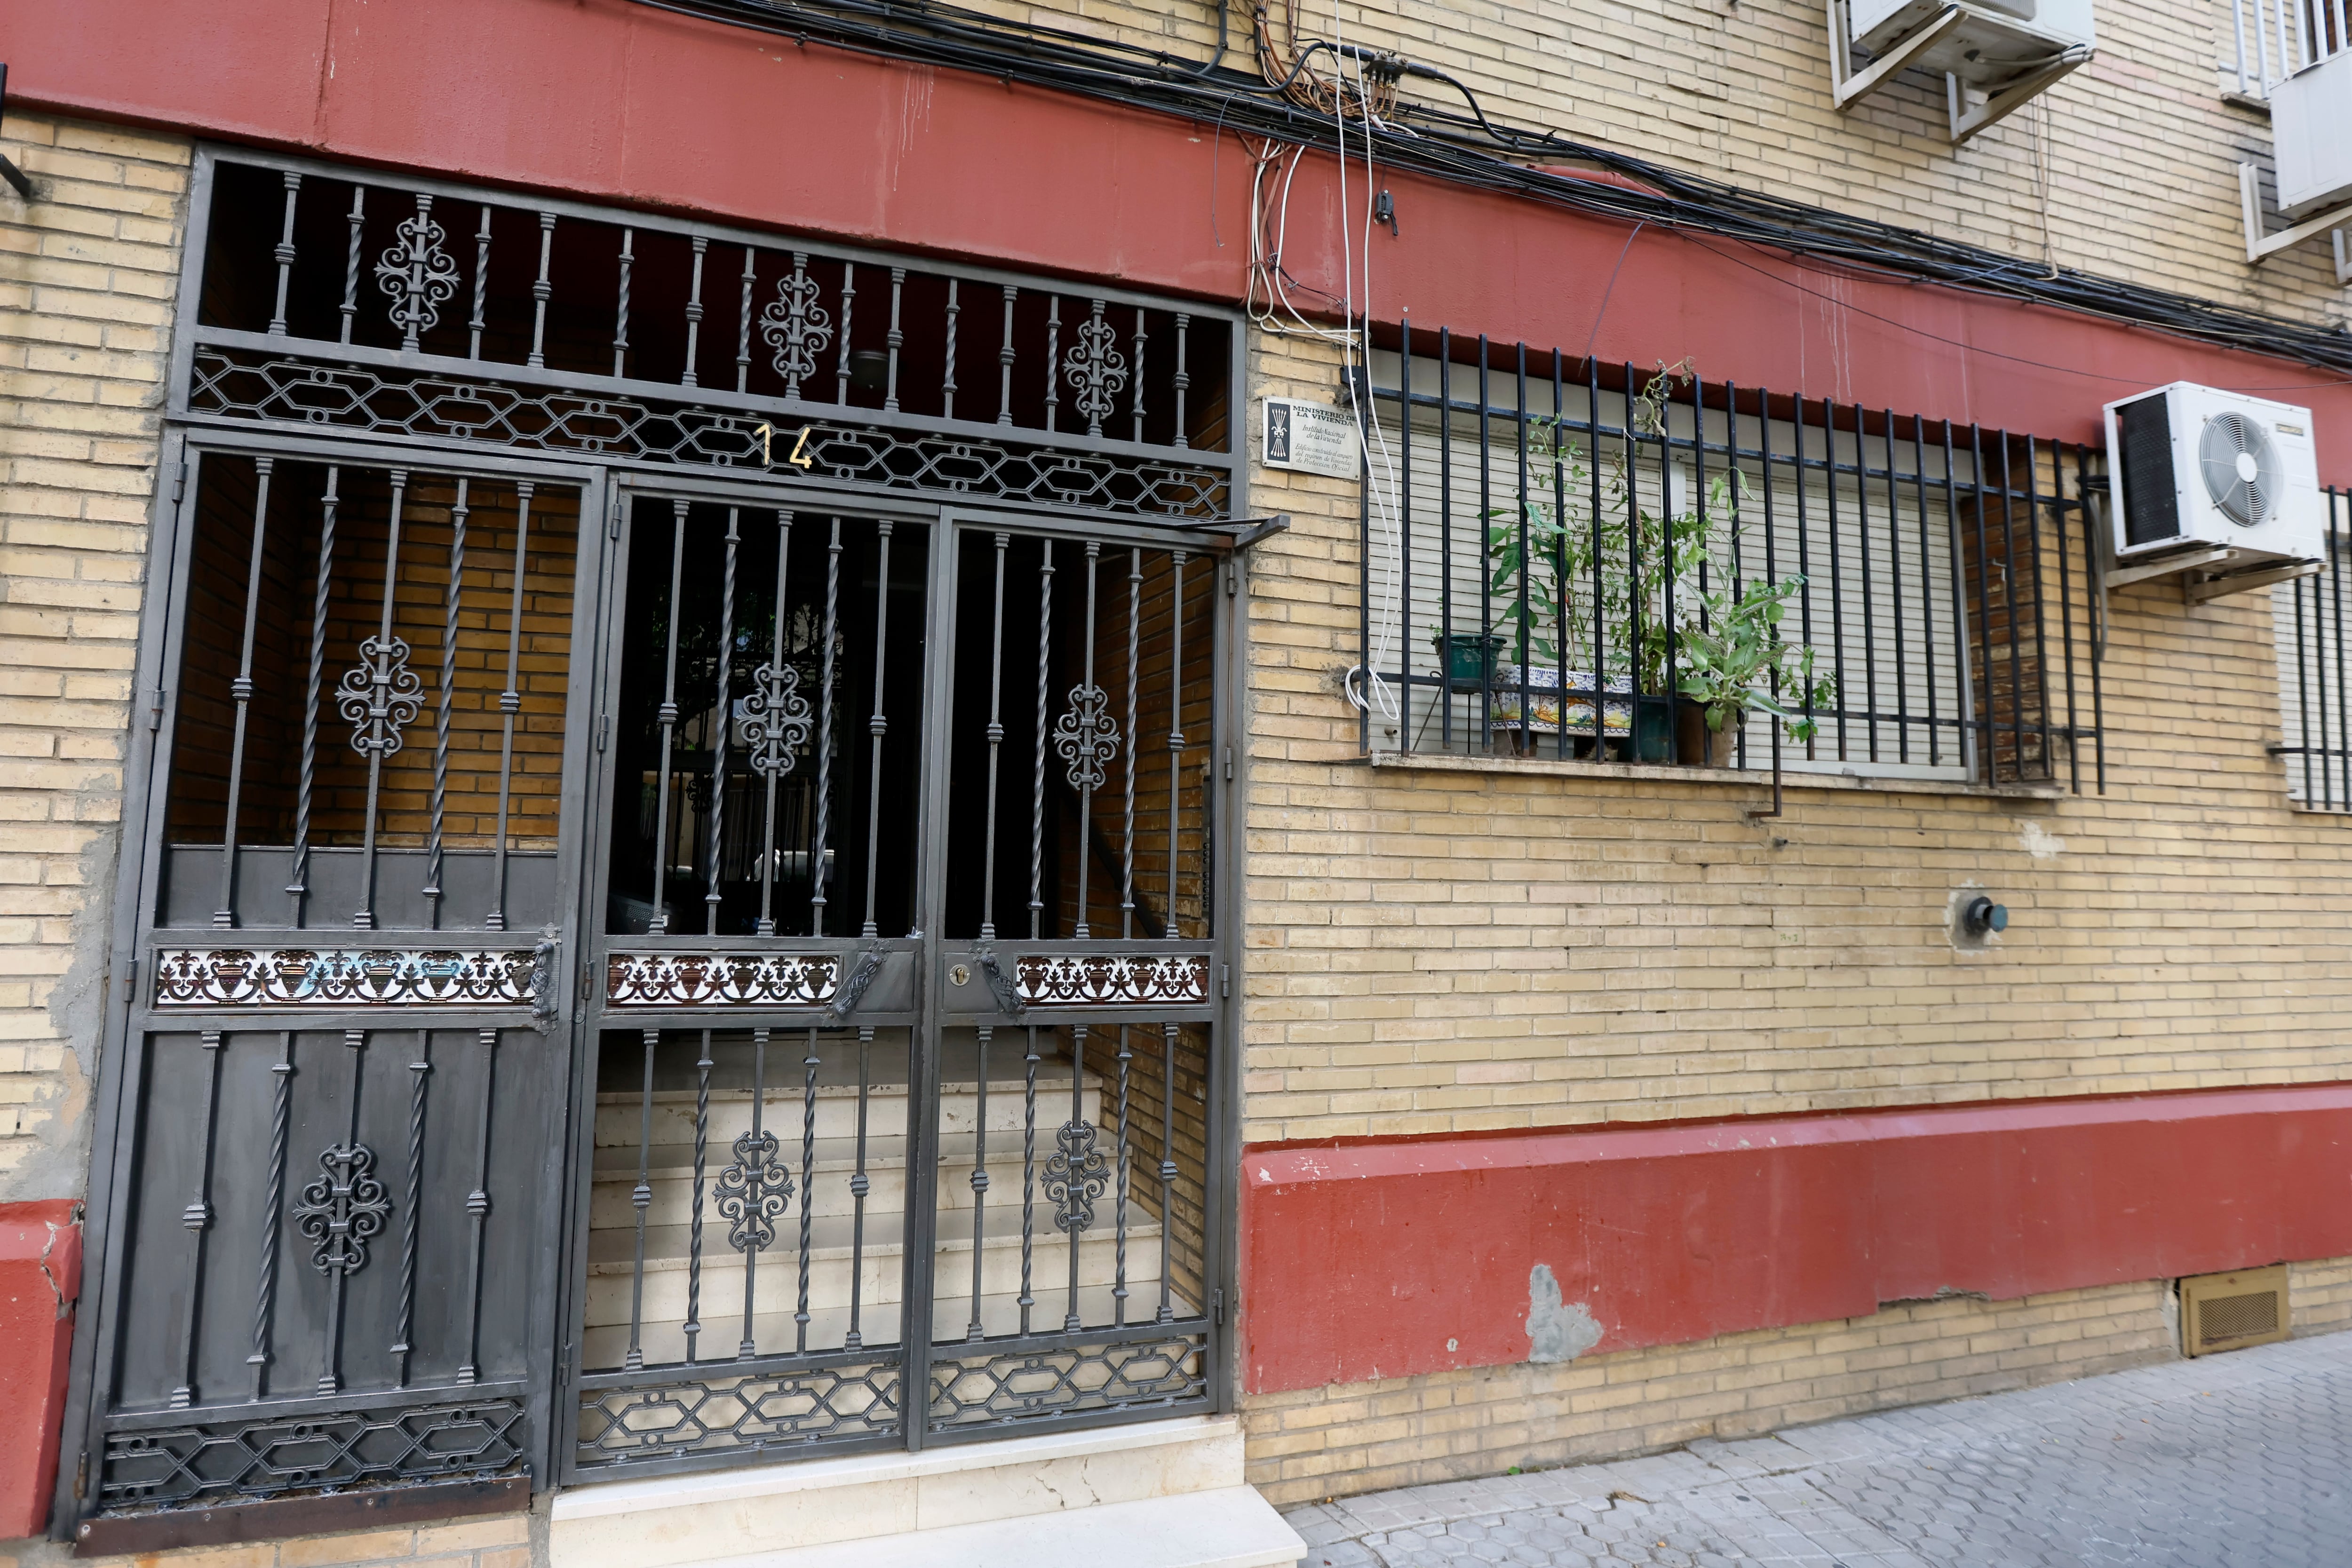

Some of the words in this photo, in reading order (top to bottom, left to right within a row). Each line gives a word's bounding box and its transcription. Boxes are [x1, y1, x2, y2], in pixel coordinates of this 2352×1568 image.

[1293, 406, 1344, 420] MINISTERIO
[1311, 414, 1354, 426] VIVIENDA
[1302, 424, 1324, 434] Instituto
[1324, 428, 1346, 439] Nacional
[1320, 434, 1342, 445] Vivienda
[753, 424, 812, 469] 14
[1331, 456, 1352, 466] Viviendas
[1331, 463, 1351, 472] Oficial
